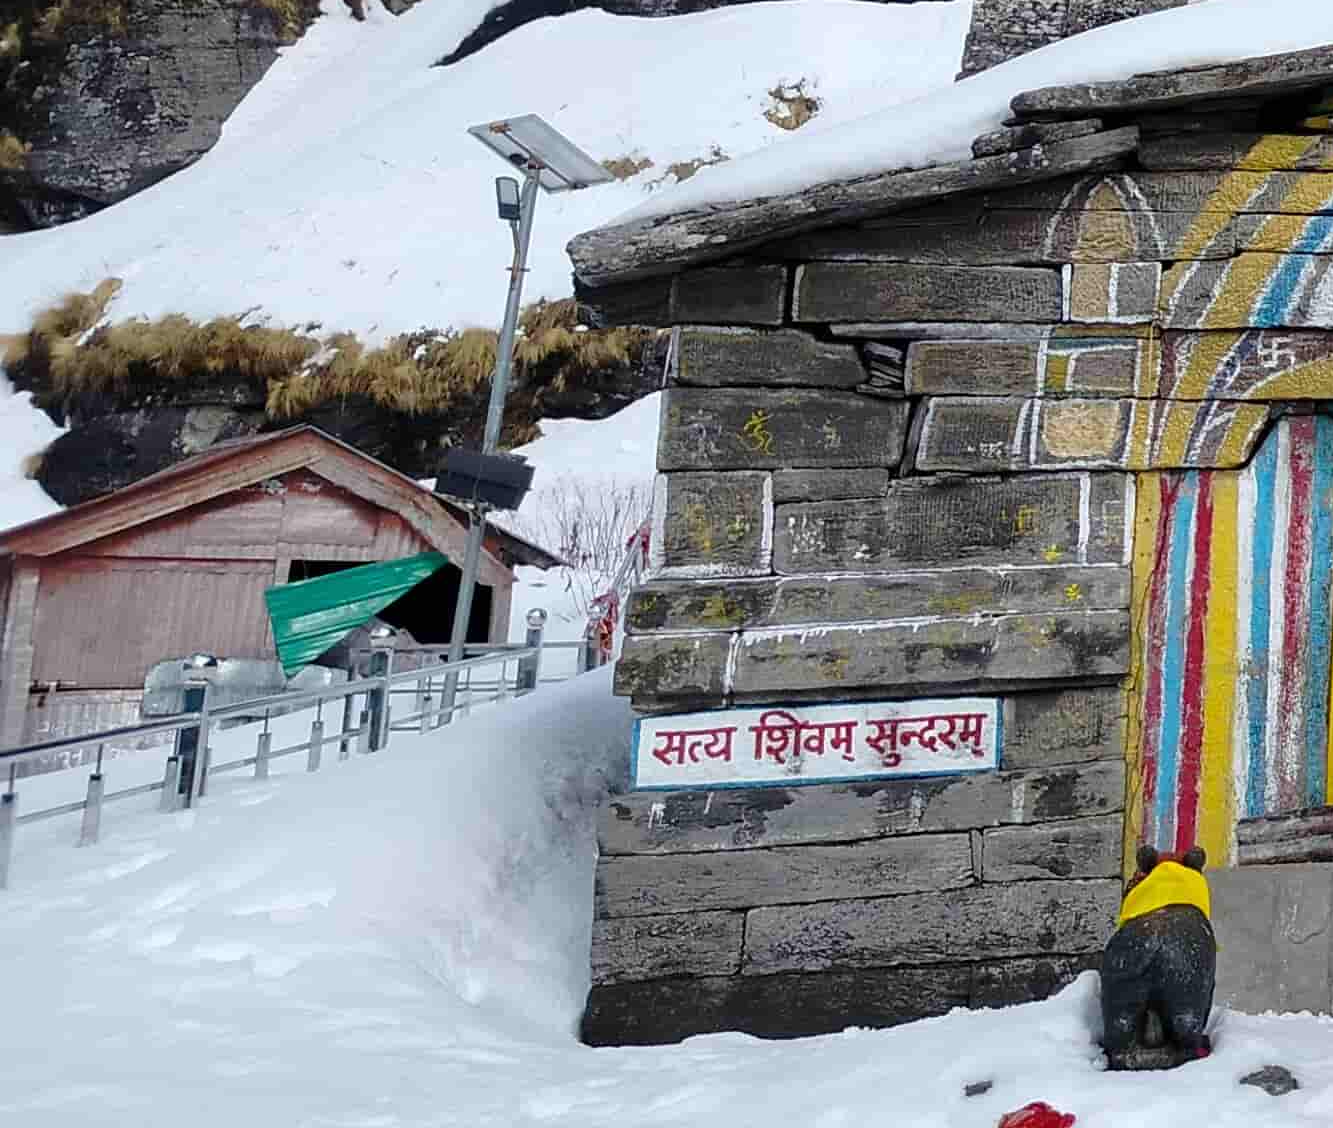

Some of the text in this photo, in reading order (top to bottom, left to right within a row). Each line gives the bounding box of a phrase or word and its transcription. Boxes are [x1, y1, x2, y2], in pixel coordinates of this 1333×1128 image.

[653, 710, 987, 767] सत्य शिवम् सुन्दरम्
